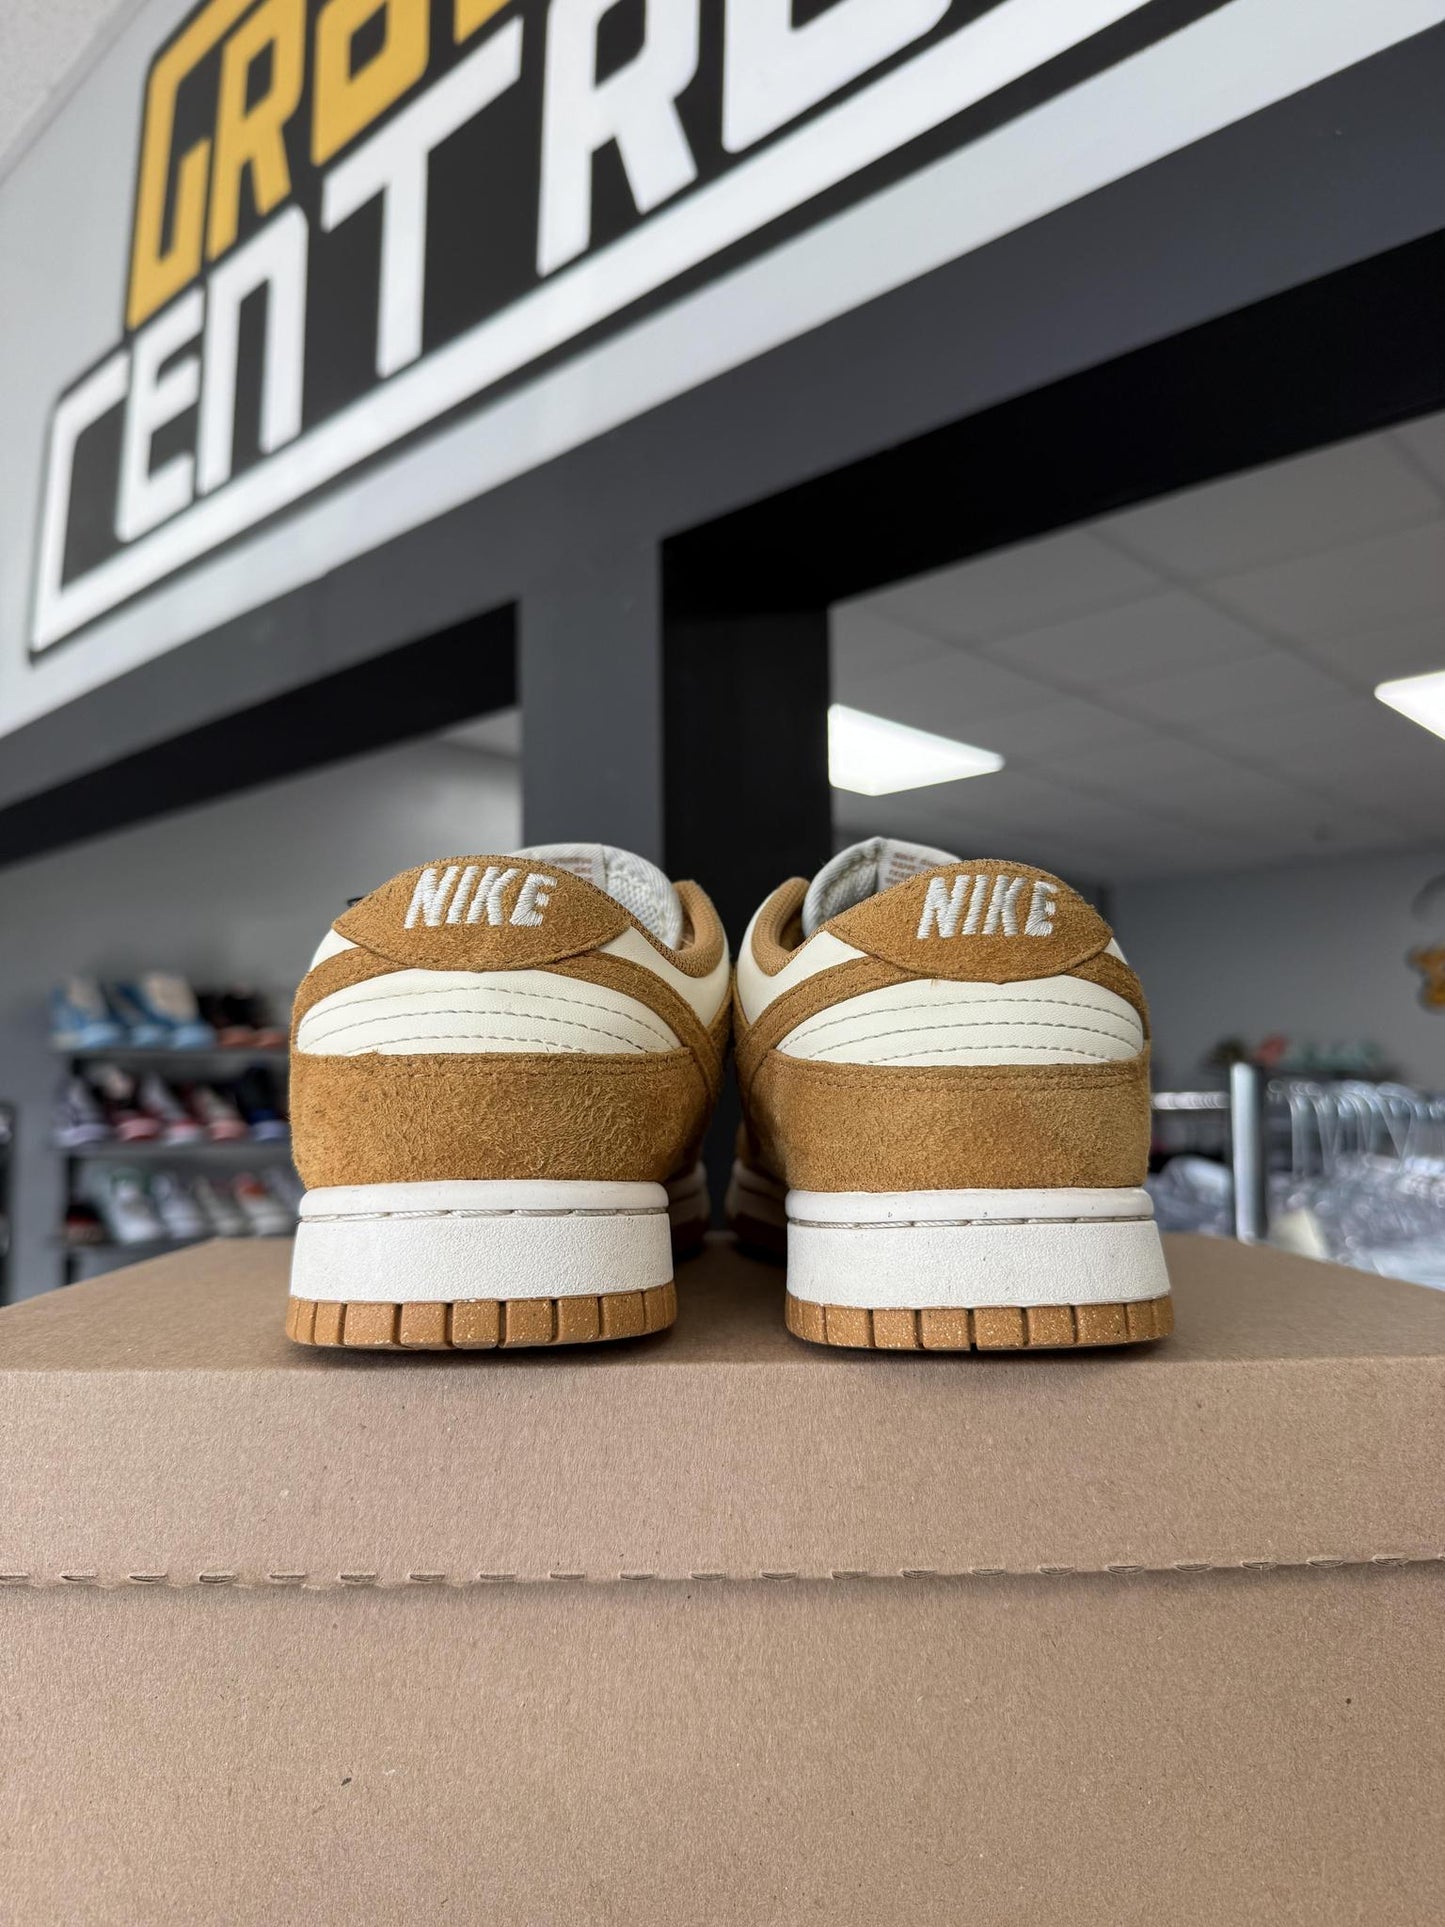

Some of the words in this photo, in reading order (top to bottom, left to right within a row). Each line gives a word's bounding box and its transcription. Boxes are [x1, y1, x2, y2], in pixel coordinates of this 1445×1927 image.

[126, 0, 514, 332] GRO
[404, 866, 558, 929] NIKE
[916, 874, 1058, 940] NIKE
